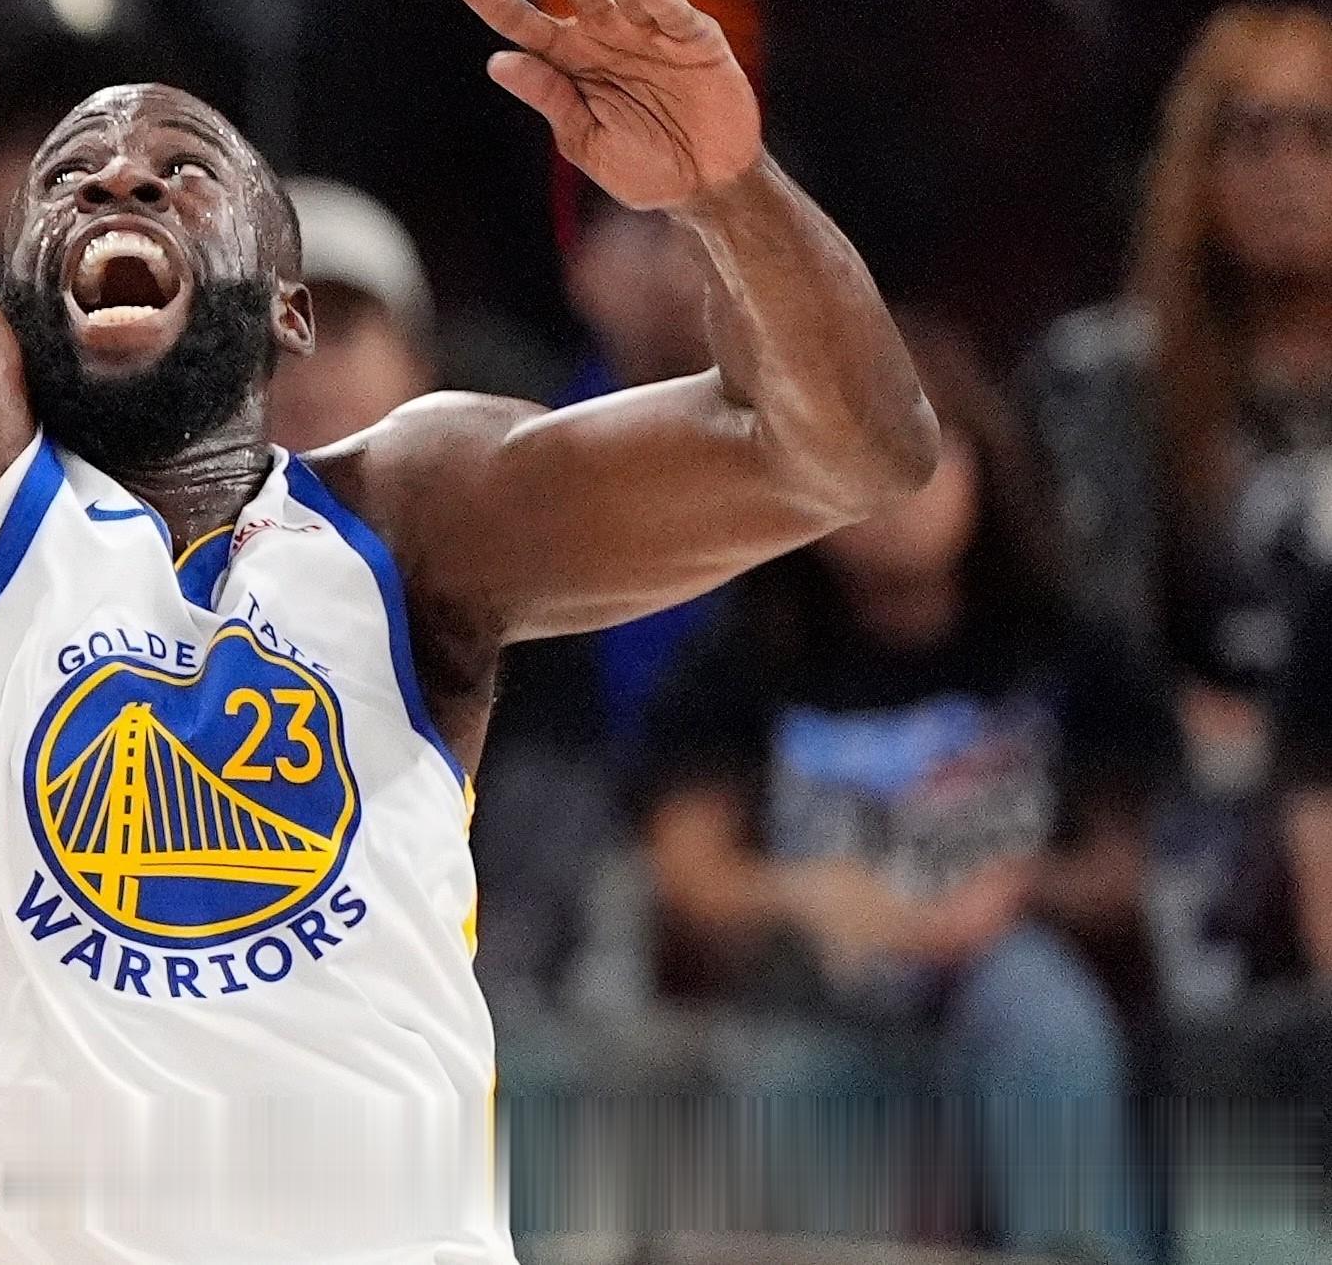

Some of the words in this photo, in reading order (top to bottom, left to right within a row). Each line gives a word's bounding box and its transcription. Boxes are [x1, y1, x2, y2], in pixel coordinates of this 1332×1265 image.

[57, 627, 197, 676] GOLDE
[248, 591, 333, 679] TATE
[221, 687, 325, 785] 23
[14, 870, 368, 999] WARRIORS
